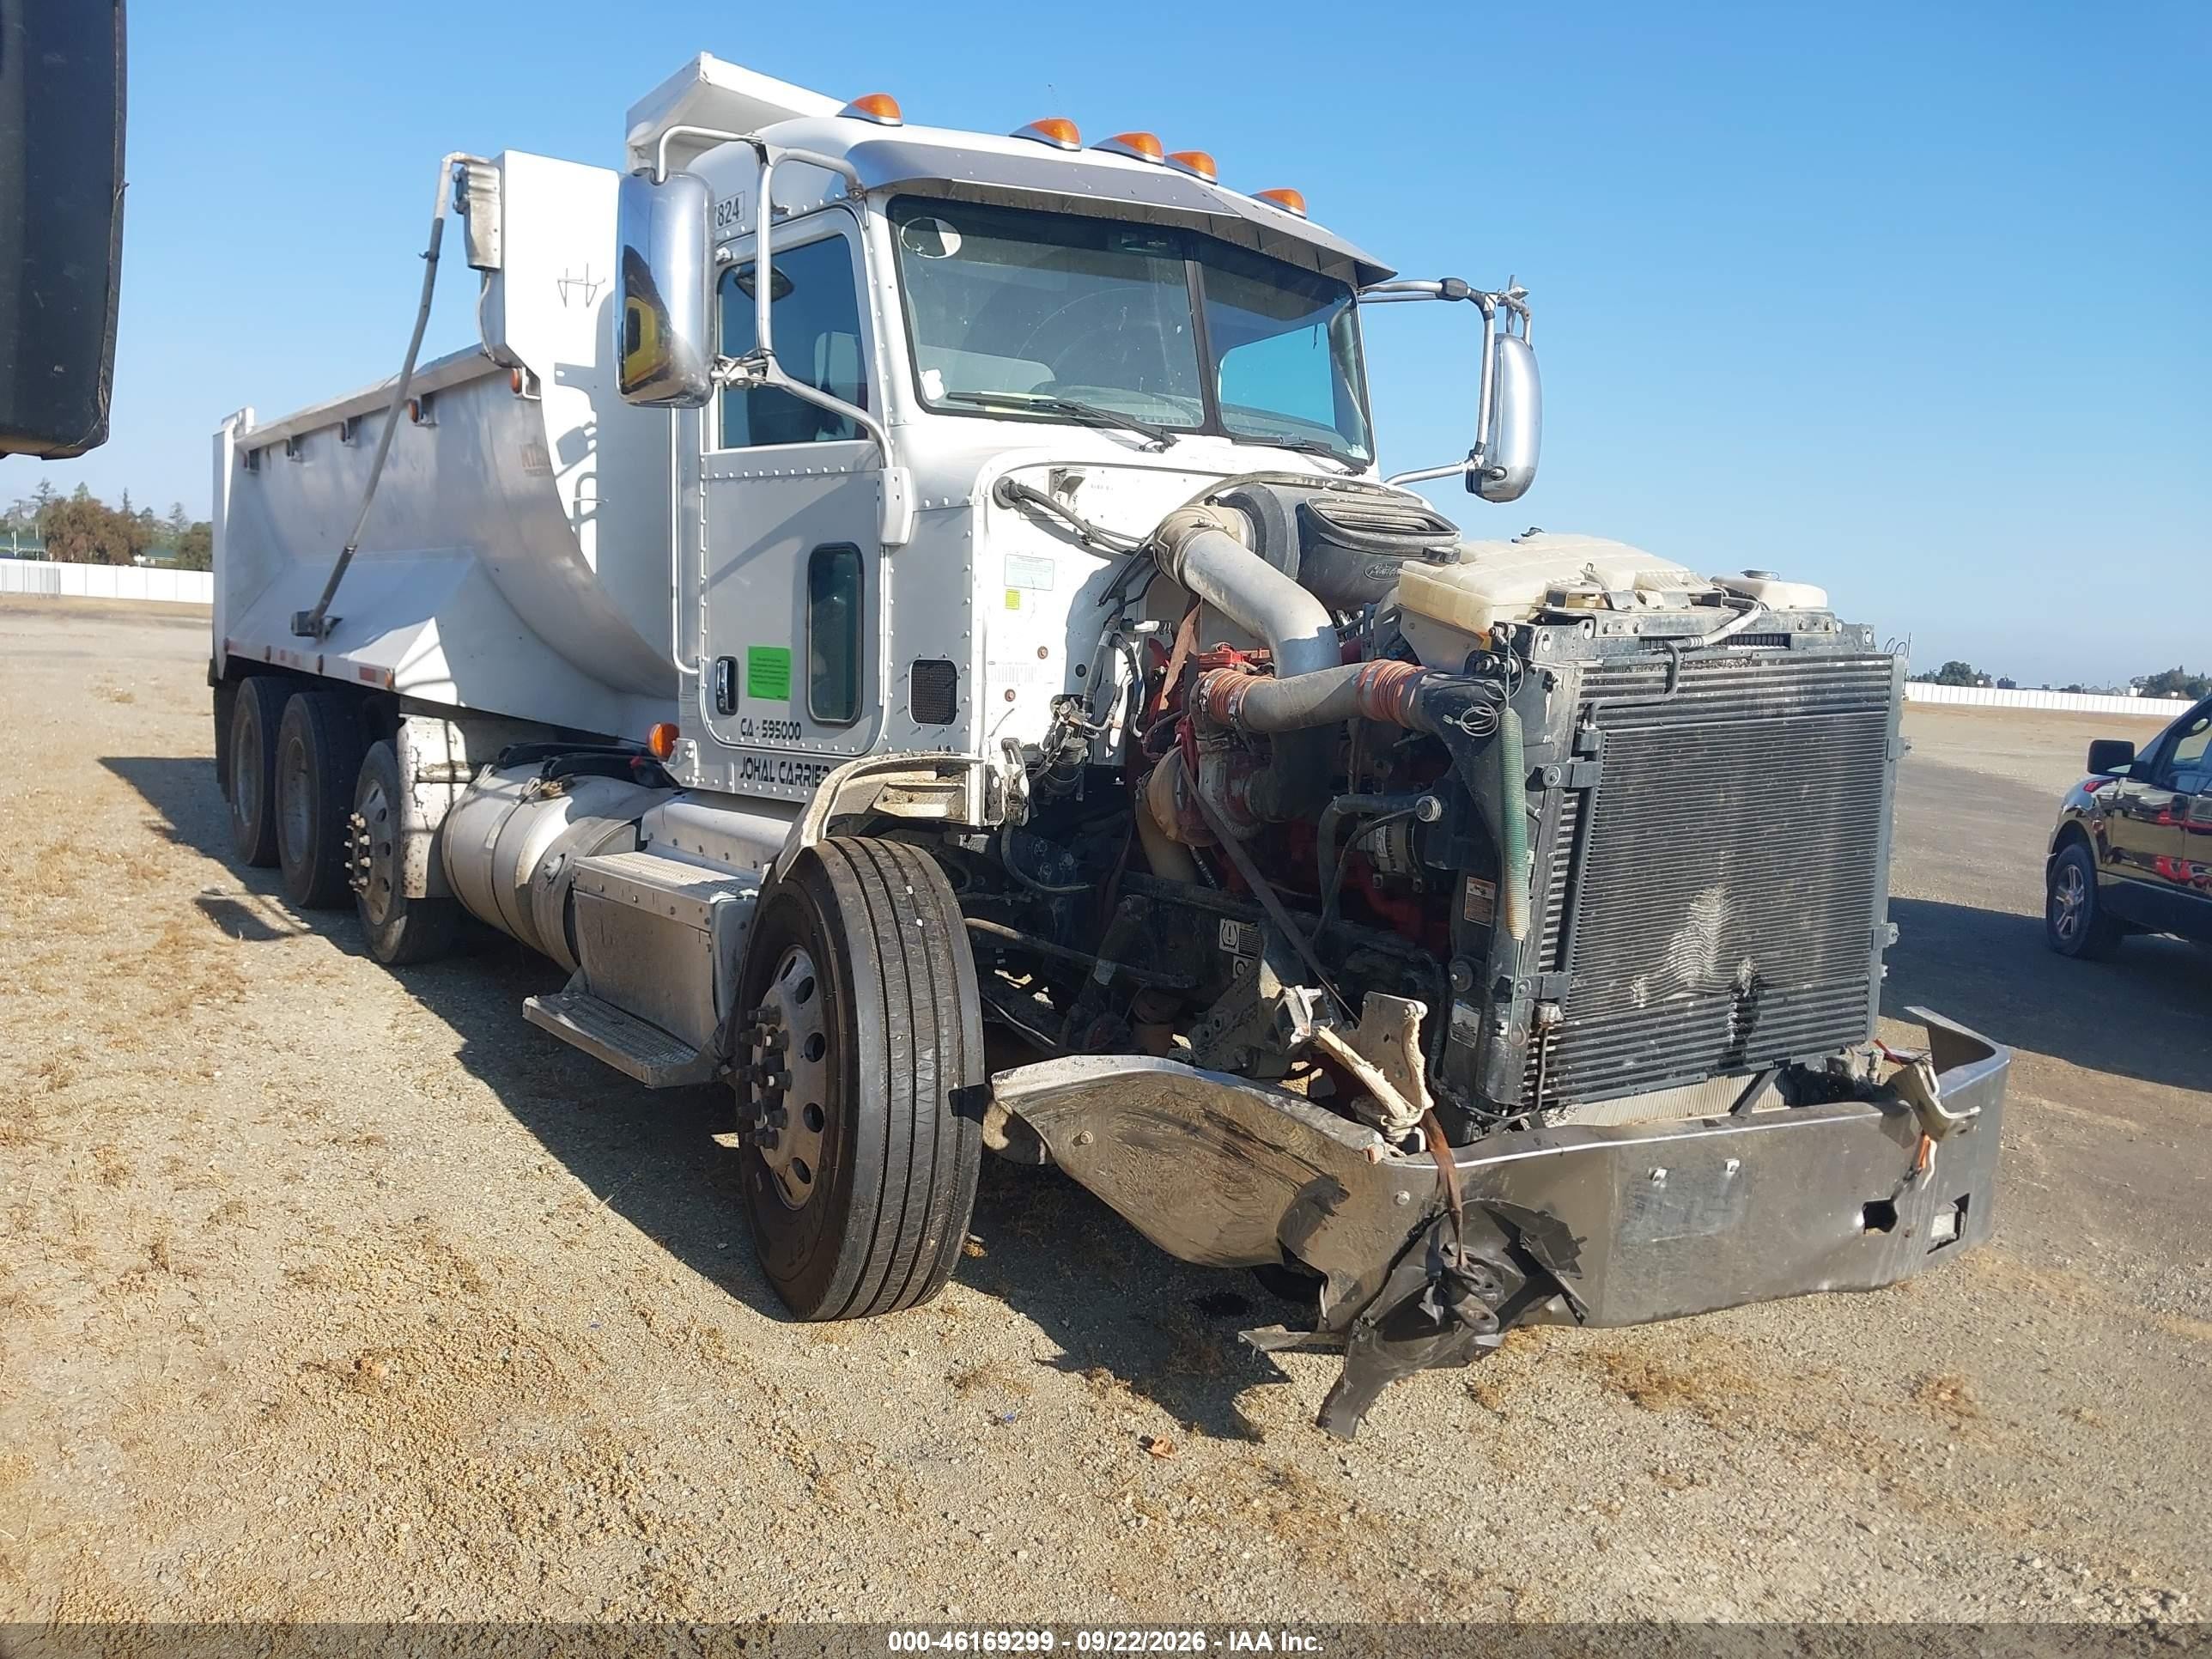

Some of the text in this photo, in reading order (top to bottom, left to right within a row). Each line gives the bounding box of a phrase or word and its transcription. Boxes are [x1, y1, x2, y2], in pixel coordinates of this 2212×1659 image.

[714, 198, 739, 227] 824
[740, 718, 754, 737] CA
[762, 719, 802, 741] 595000
[739, 757, 775, 783] JOHAL
